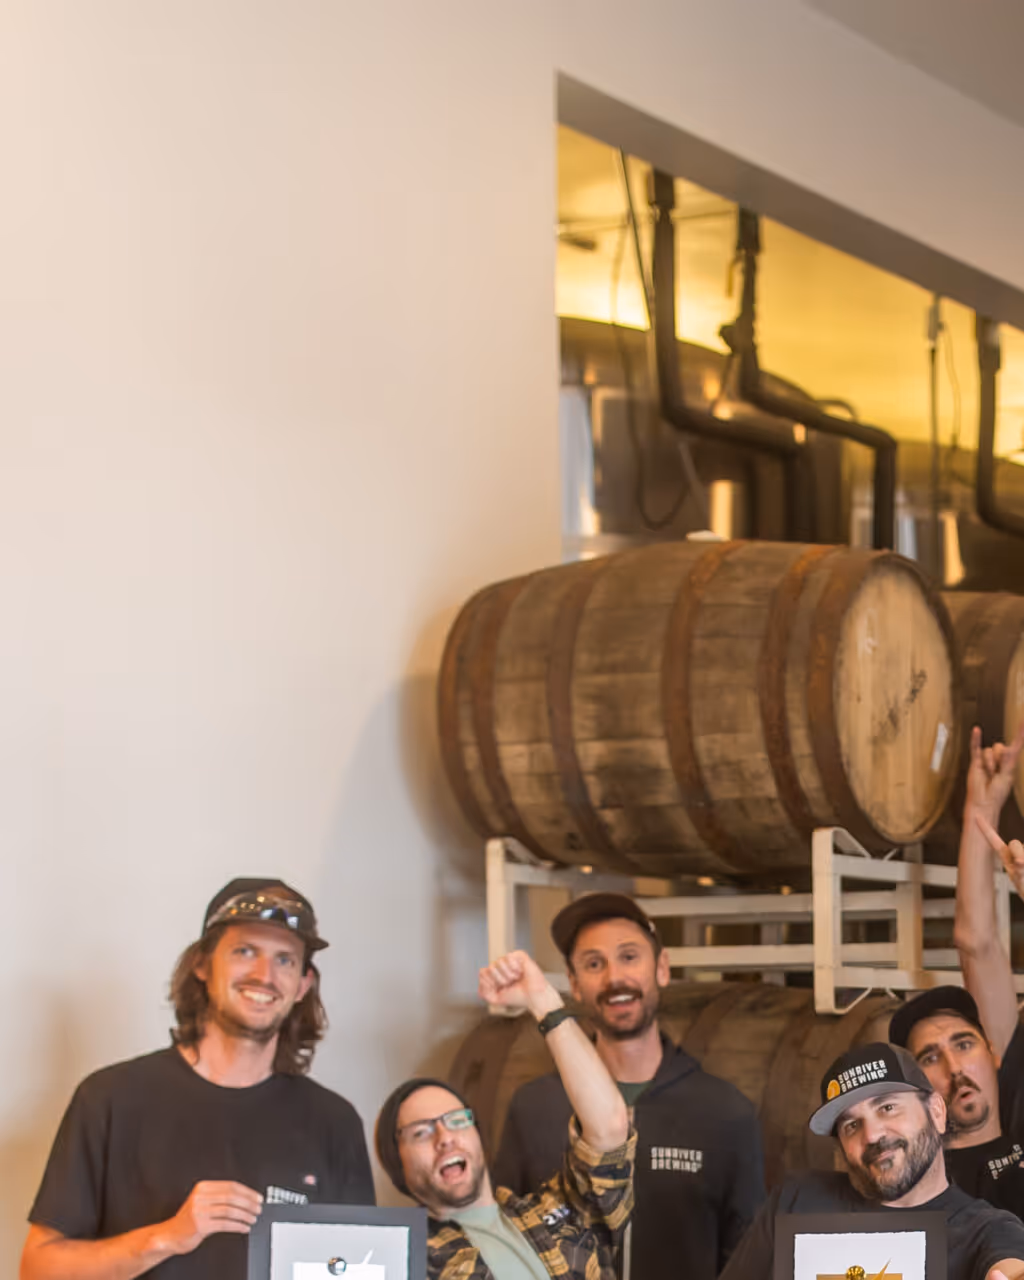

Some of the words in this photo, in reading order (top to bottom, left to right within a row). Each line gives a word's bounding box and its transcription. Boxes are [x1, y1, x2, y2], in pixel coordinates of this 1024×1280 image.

[838, 1059, 886, 1084] SUNRIVER
[841, 1069, 885, 1093] BREWING
[651, 1147, 702, 1161] SUNRIVER
[651, 1159, 698, 1172] BREWING
